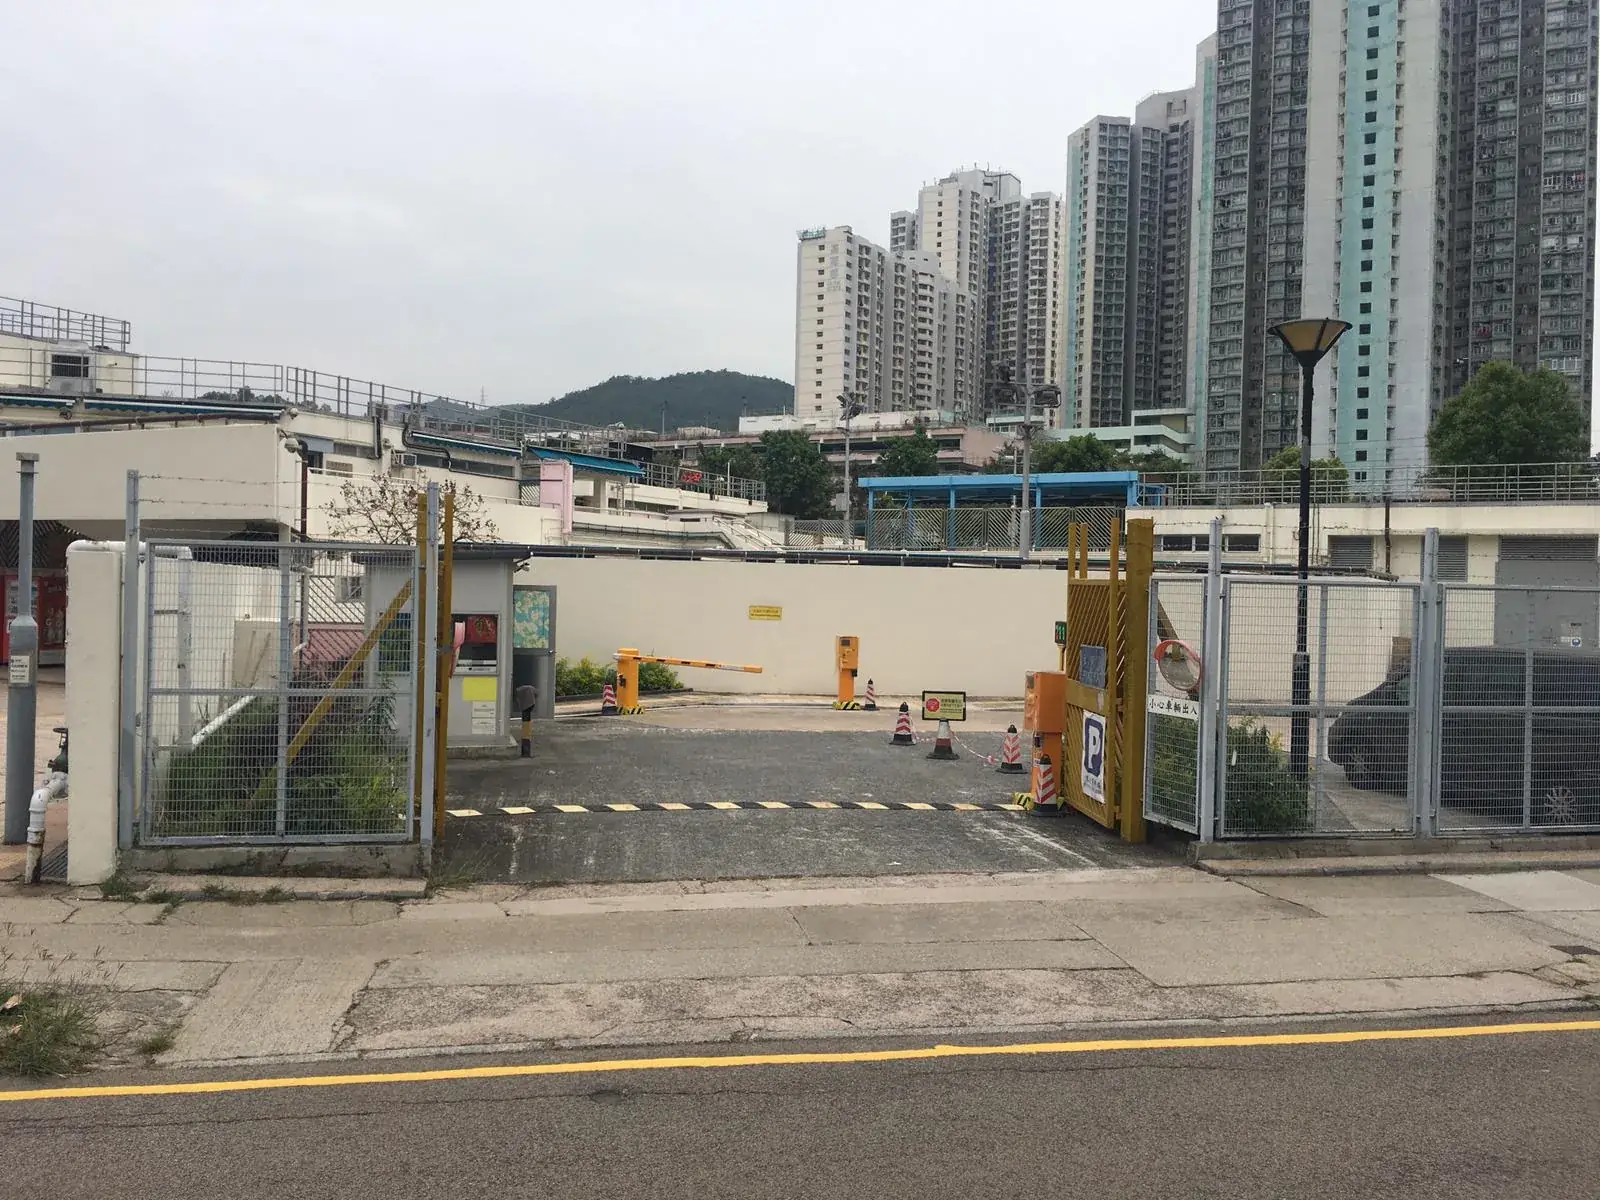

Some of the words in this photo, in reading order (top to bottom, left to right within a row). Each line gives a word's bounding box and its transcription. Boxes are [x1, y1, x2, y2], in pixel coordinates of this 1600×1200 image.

[1149, 698, 1198, 715] 小心車輛出入
[1088, 725, 1101, 769] P
